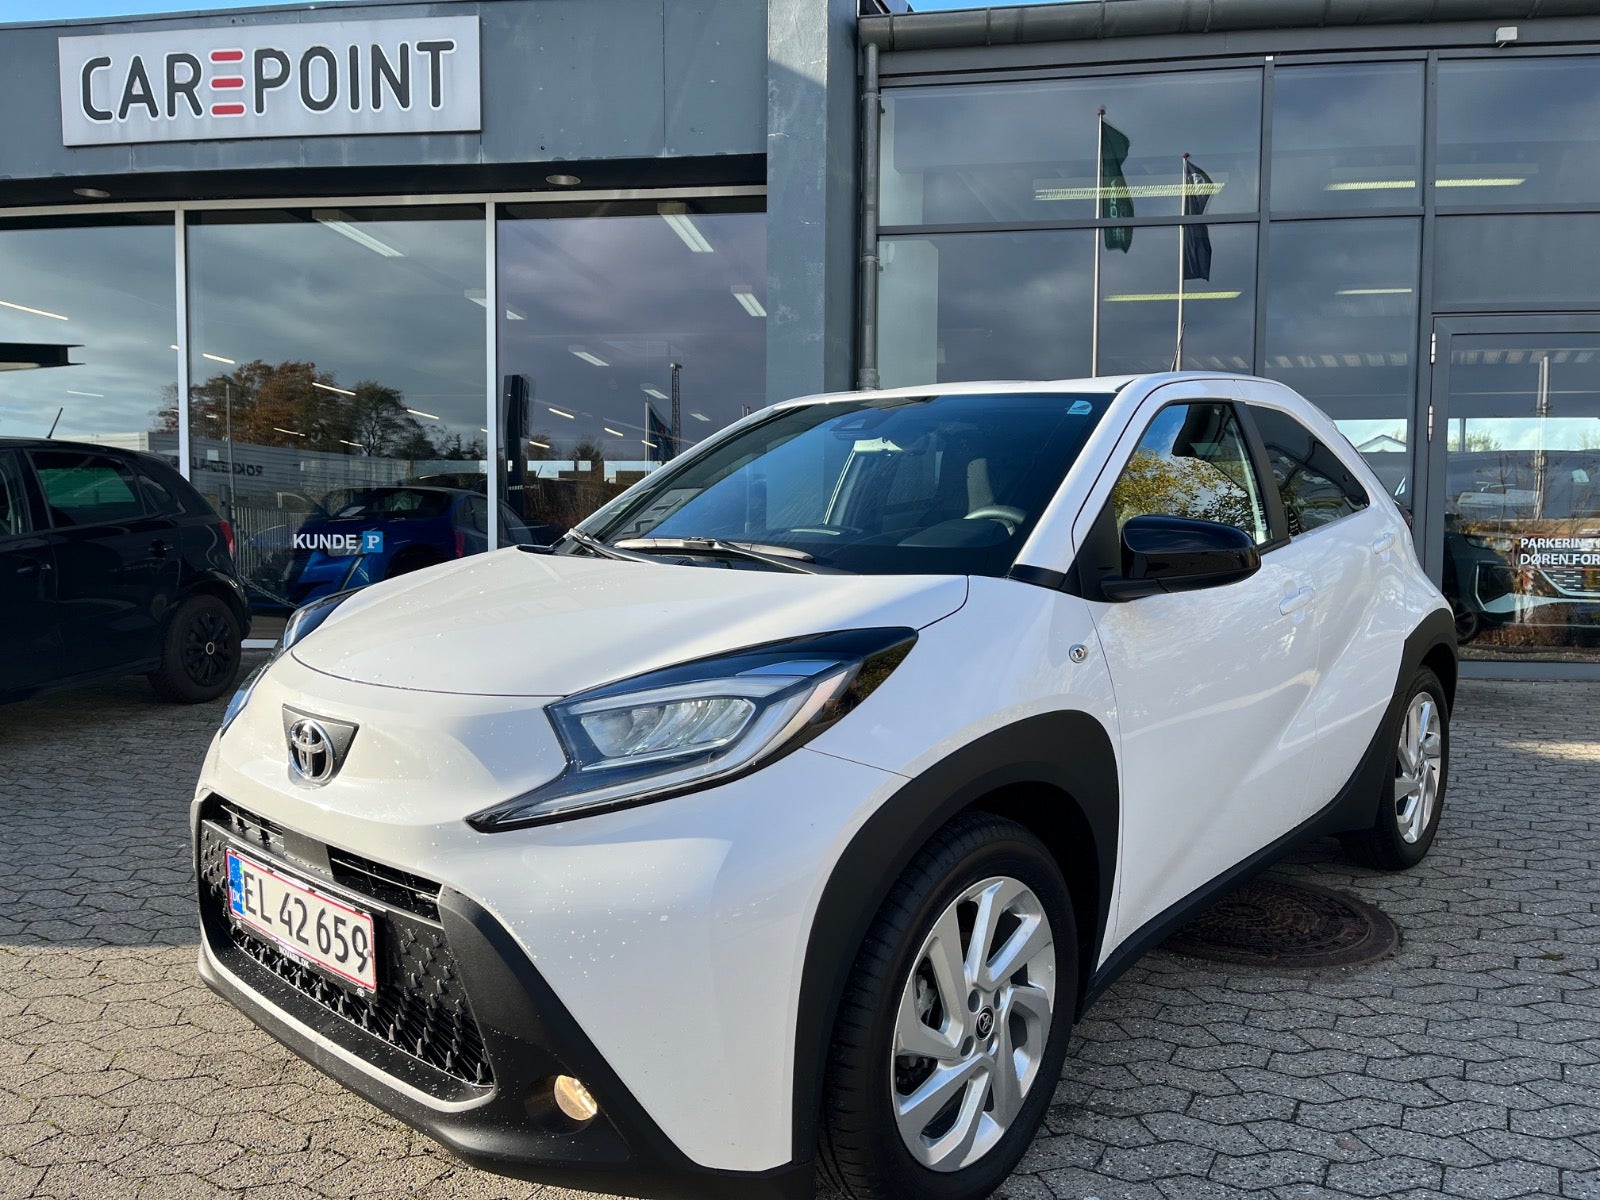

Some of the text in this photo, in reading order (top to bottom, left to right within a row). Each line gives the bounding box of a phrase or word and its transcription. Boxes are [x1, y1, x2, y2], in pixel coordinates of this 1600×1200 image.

[81, 40, 455, 121] CAREPOINT
[293, 533, 380, 549] KUNDE P
[1520, 553, 1600, 565] DØREN FOR
[232, 888, 242, 904] DK
[243, 870, 272, 925] EL
[280, 892, 309, 946] 42
[316, 908, 368, 973] 659
